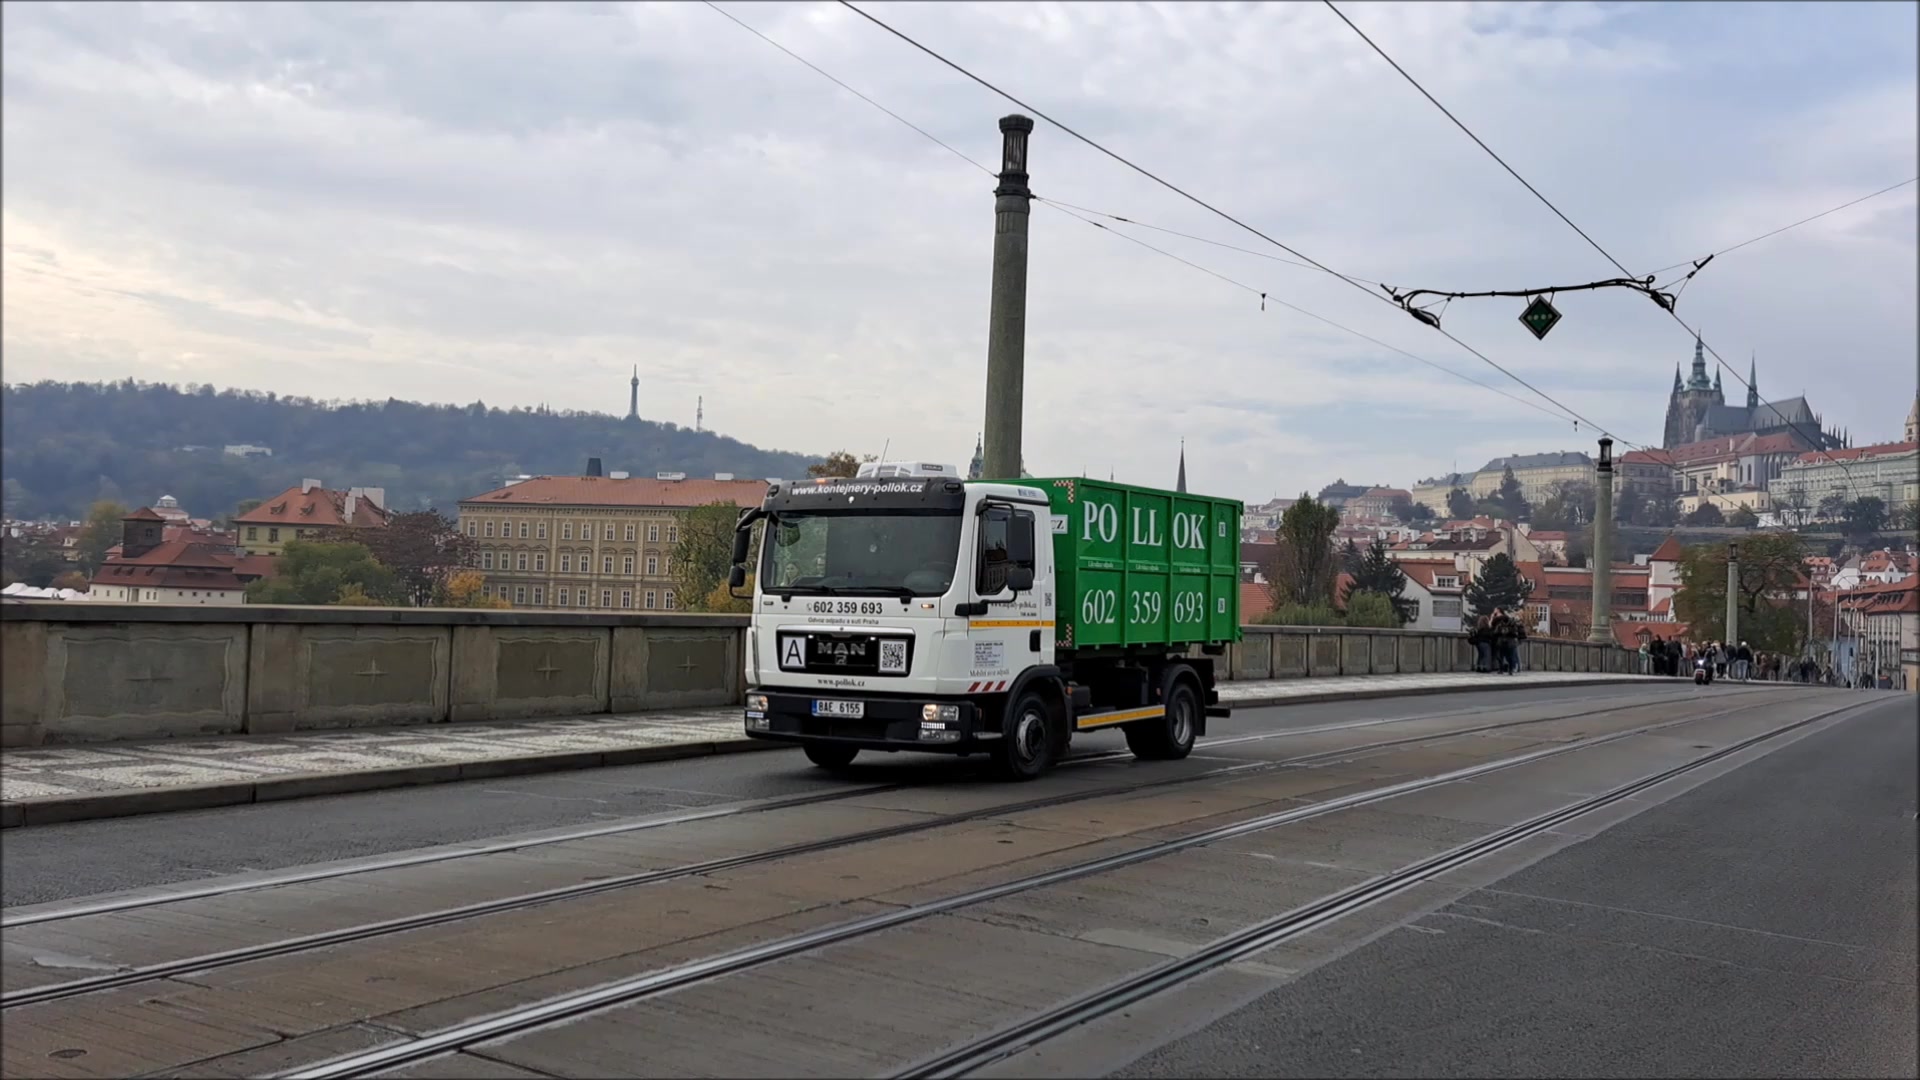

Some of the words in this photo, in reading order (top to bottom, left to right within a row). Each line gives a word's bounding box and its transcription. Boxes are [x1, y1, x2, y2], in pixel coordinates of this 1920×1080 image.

[791, 482, 923, 496] www.kontejnery-pollok.cz
[813, 601, 833, 613] 602
[837, 601, 857, 614] 359
[861, 602, 883, 614] 693
[1082, 589, 1115, 624] 602
[1130, 590, 1161, 624] 359
[1174, 591, 1204, 623] 693
[785, 639, 803, 665] A
[817, 642, 866, 655] MAN
[817, 678, 865, 688] www.pollok.cz
[839, 702, 861, 714] 6155
